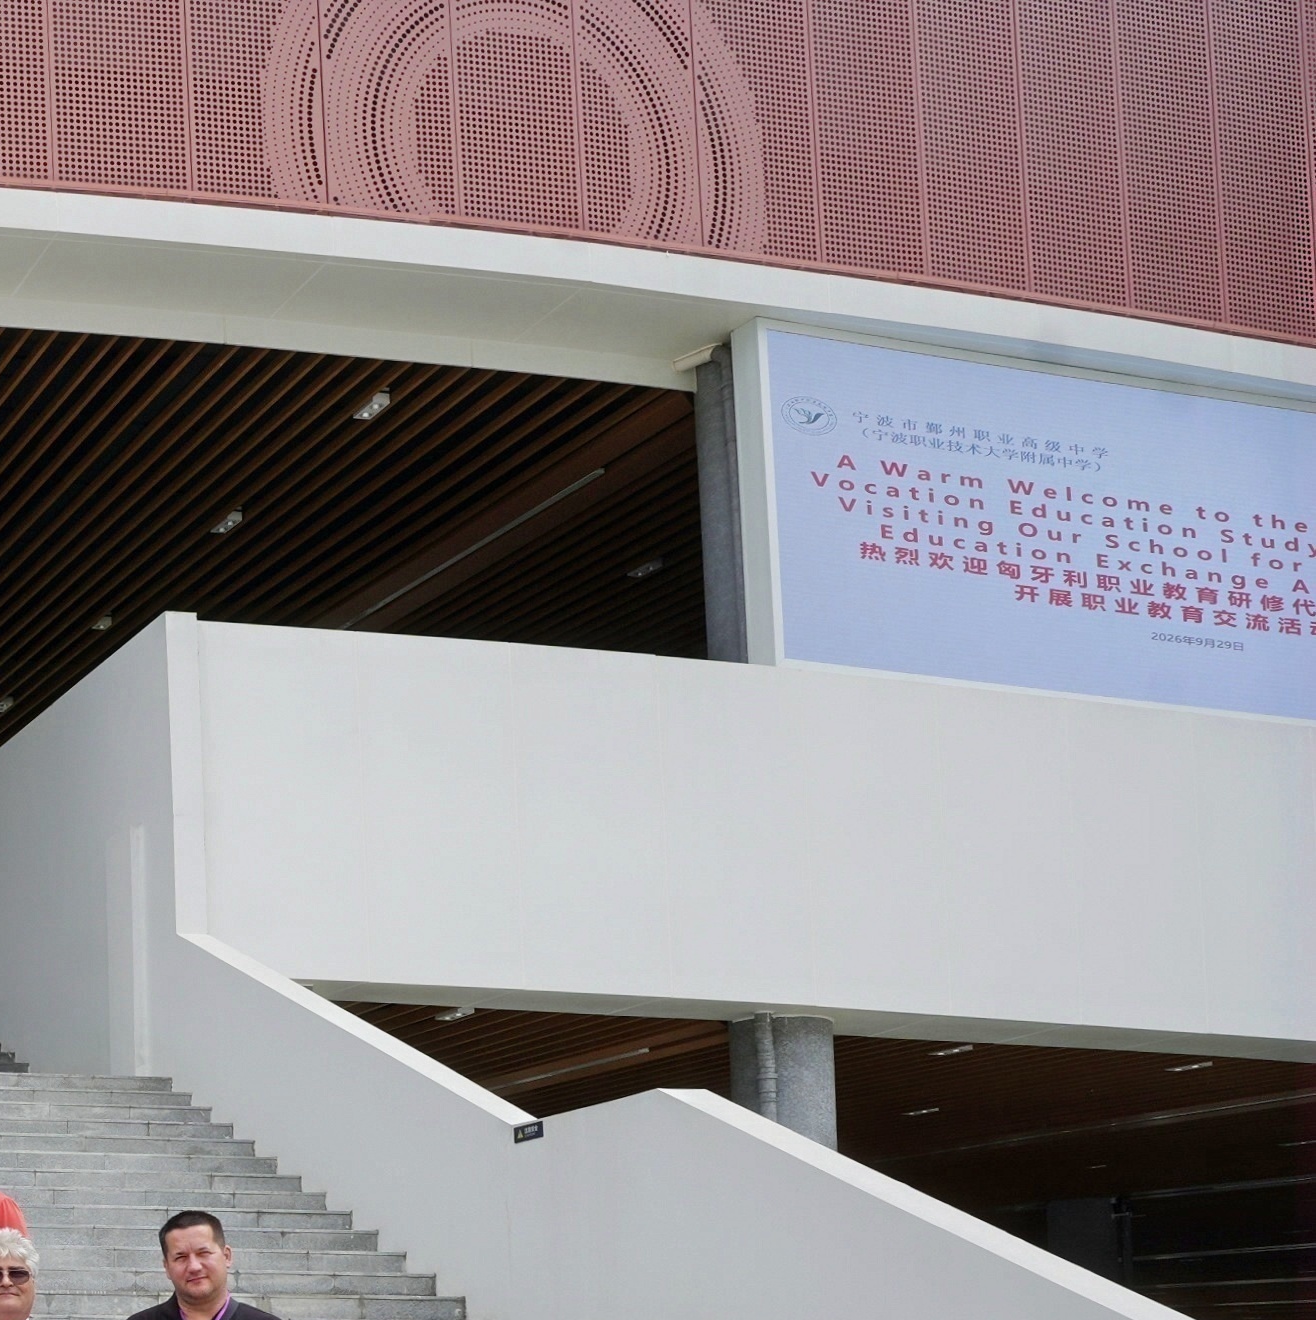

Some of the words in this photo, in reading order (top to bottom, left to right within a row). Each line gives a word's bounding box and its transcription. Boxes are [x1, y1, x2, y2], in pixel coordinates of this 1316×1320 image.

[852, 410, 1109, 459] 宁波市鄞州职业高级中学
[811, 471, 984, 510] Vocation
[1009, 500, 1196, 539] Education
[837, 454, 857, 471] A
[880, 460, 983, 489] Warm
[1007, 478, 1173, 515] Welcome
[1196, 506, 1230, 523] to
[1252, 514, 1308, 532] the
[838, 496, 994, 536] Visiting
[1018, 522, 1082, 544] Our
[1105, 534, 1227, 564] School
[1240, 552, 1302, 572] for
[880, 524, 1071, 564] Education
[1096, 553, 1269, 590] Exchange
[860, 541, 1316, 617] 热烈欢迎匈牙利职业教育研修代
